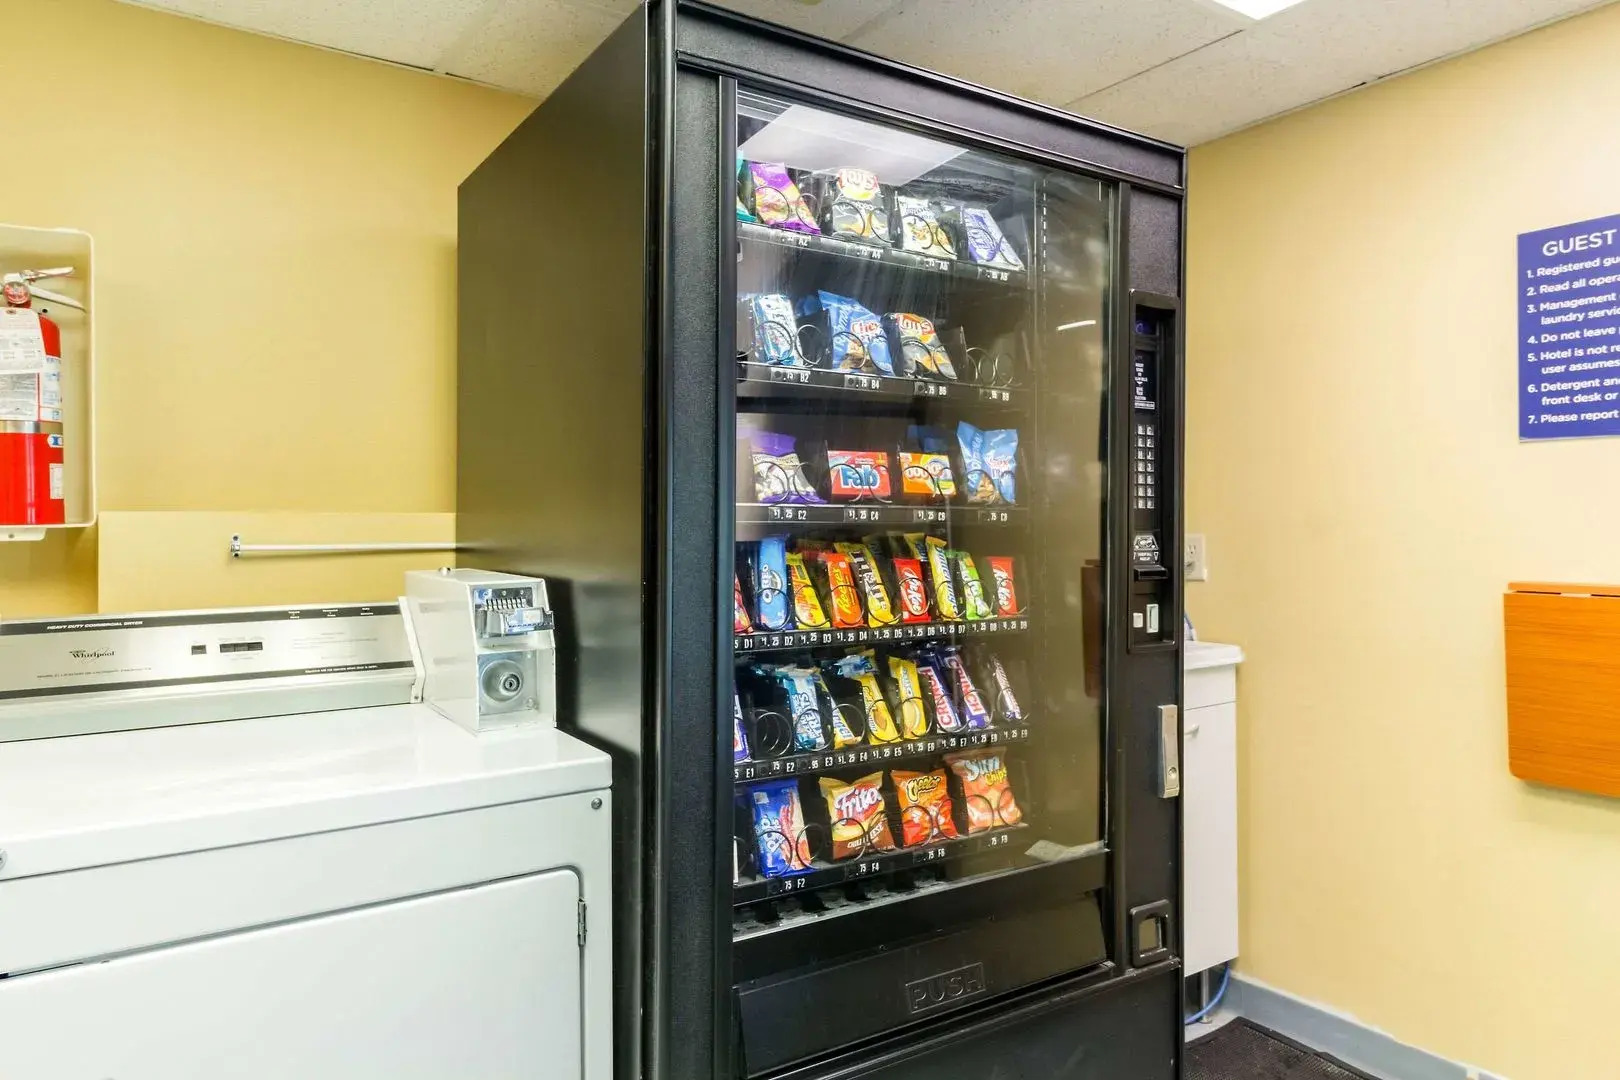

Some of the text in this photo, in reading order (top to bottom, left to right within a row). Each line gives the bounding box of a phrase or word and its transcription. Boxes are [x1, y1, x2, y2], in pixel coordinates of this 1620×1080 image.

[1543, 229, 1617, 256] GUEST
[1526, 269, 1534, 278] 1.
[1537, 258, 1600, 276] Registered
[1527, 287, 1537, 296] 2.
[1540, 281, 1570, 294] Read
[1572, 278, 1586, 289] all
[1527, 293, 1616, 313] 3. Management
[1541, 312, 1585, 325] laundry
[1527, 327, 1616, 344] 4. Do not leave
[1527, 353, 1538, 362] 5.
[1540, 349, 1571, 360] Hotel
[1574, 348, 1584, 356] is
[1587, 345, 1608, 355] not
[1541, 360, 1620, 374] user assumes
[800, 374, 809, 382] B2
[1527, 384, 1538, 393] 6.
[1541, 379, 1600, 391] Detergent
[1542, 396, 1570, 405] front
[1573, 393, 1601, 403] desk
[1527, 410, 1619, 424] 7. Please report
[840, 465, 880, 489] Fab
[798, 510, 807, 520] C2
[785, 636, 793, 646] D2
[823, 634, 831, 643] D3
[859, 631, 868, 640] D4
[744, 638, 753, 649] D1
[72, 651, 115, 659] Whirlpool
[860, 752, 868, 761] E4
[894, 748, 902, 757] E5
[786, 762, 795, 772] E2
[825, 757, 833, 767] E3
[746, 768, 754, 778] E1
[871, 863, 879, 872] F4
[797, 879, 806, 888] F2
[912, 970, 981, 1008] PUSH
